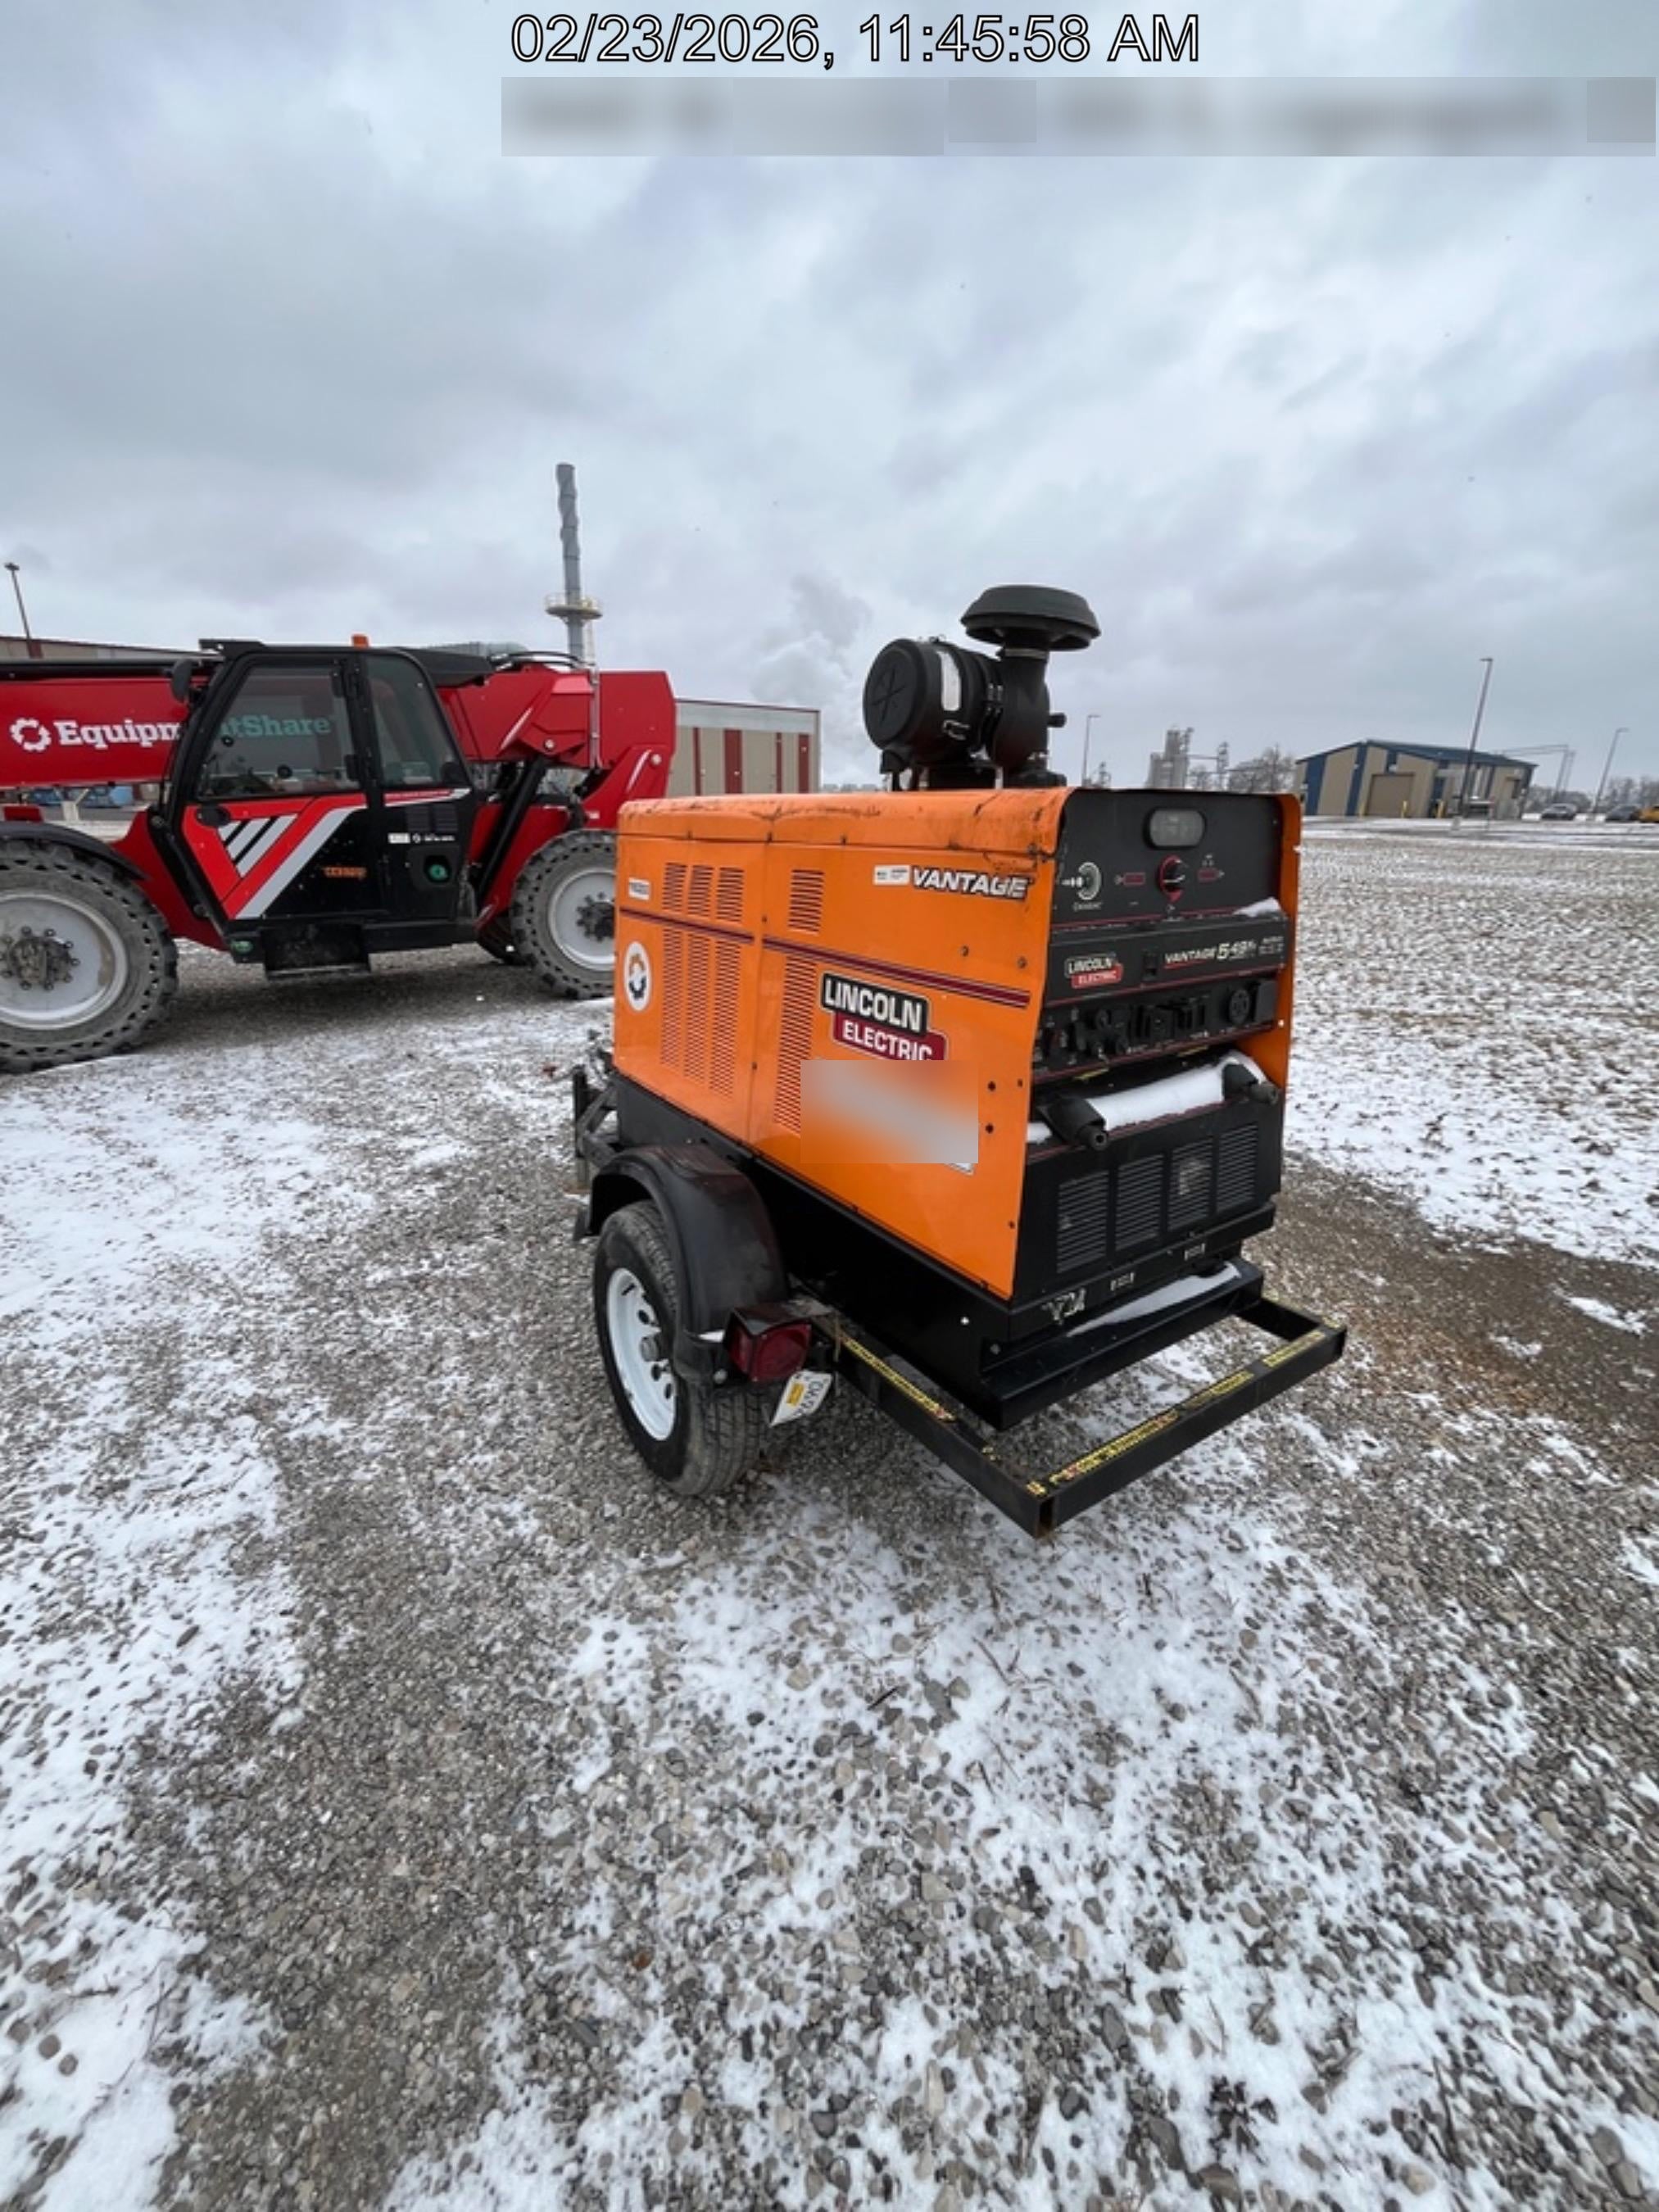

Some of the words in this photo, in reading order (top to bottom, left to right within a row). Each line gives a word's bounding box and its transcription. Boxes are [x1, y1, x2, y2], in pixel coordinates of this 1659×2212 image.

[913, 868, 1028, 898] VANTAGE
[1068, 957, 1112, 975] LINCOLN
[1165, 947, 1217, 963] VANTAGE
[1079, 970, 1117, 985] ELECTRIC
[825, 978, 921, 1033] LINCOLN
[842, 1019, 932, 1060] ELECTRIC
